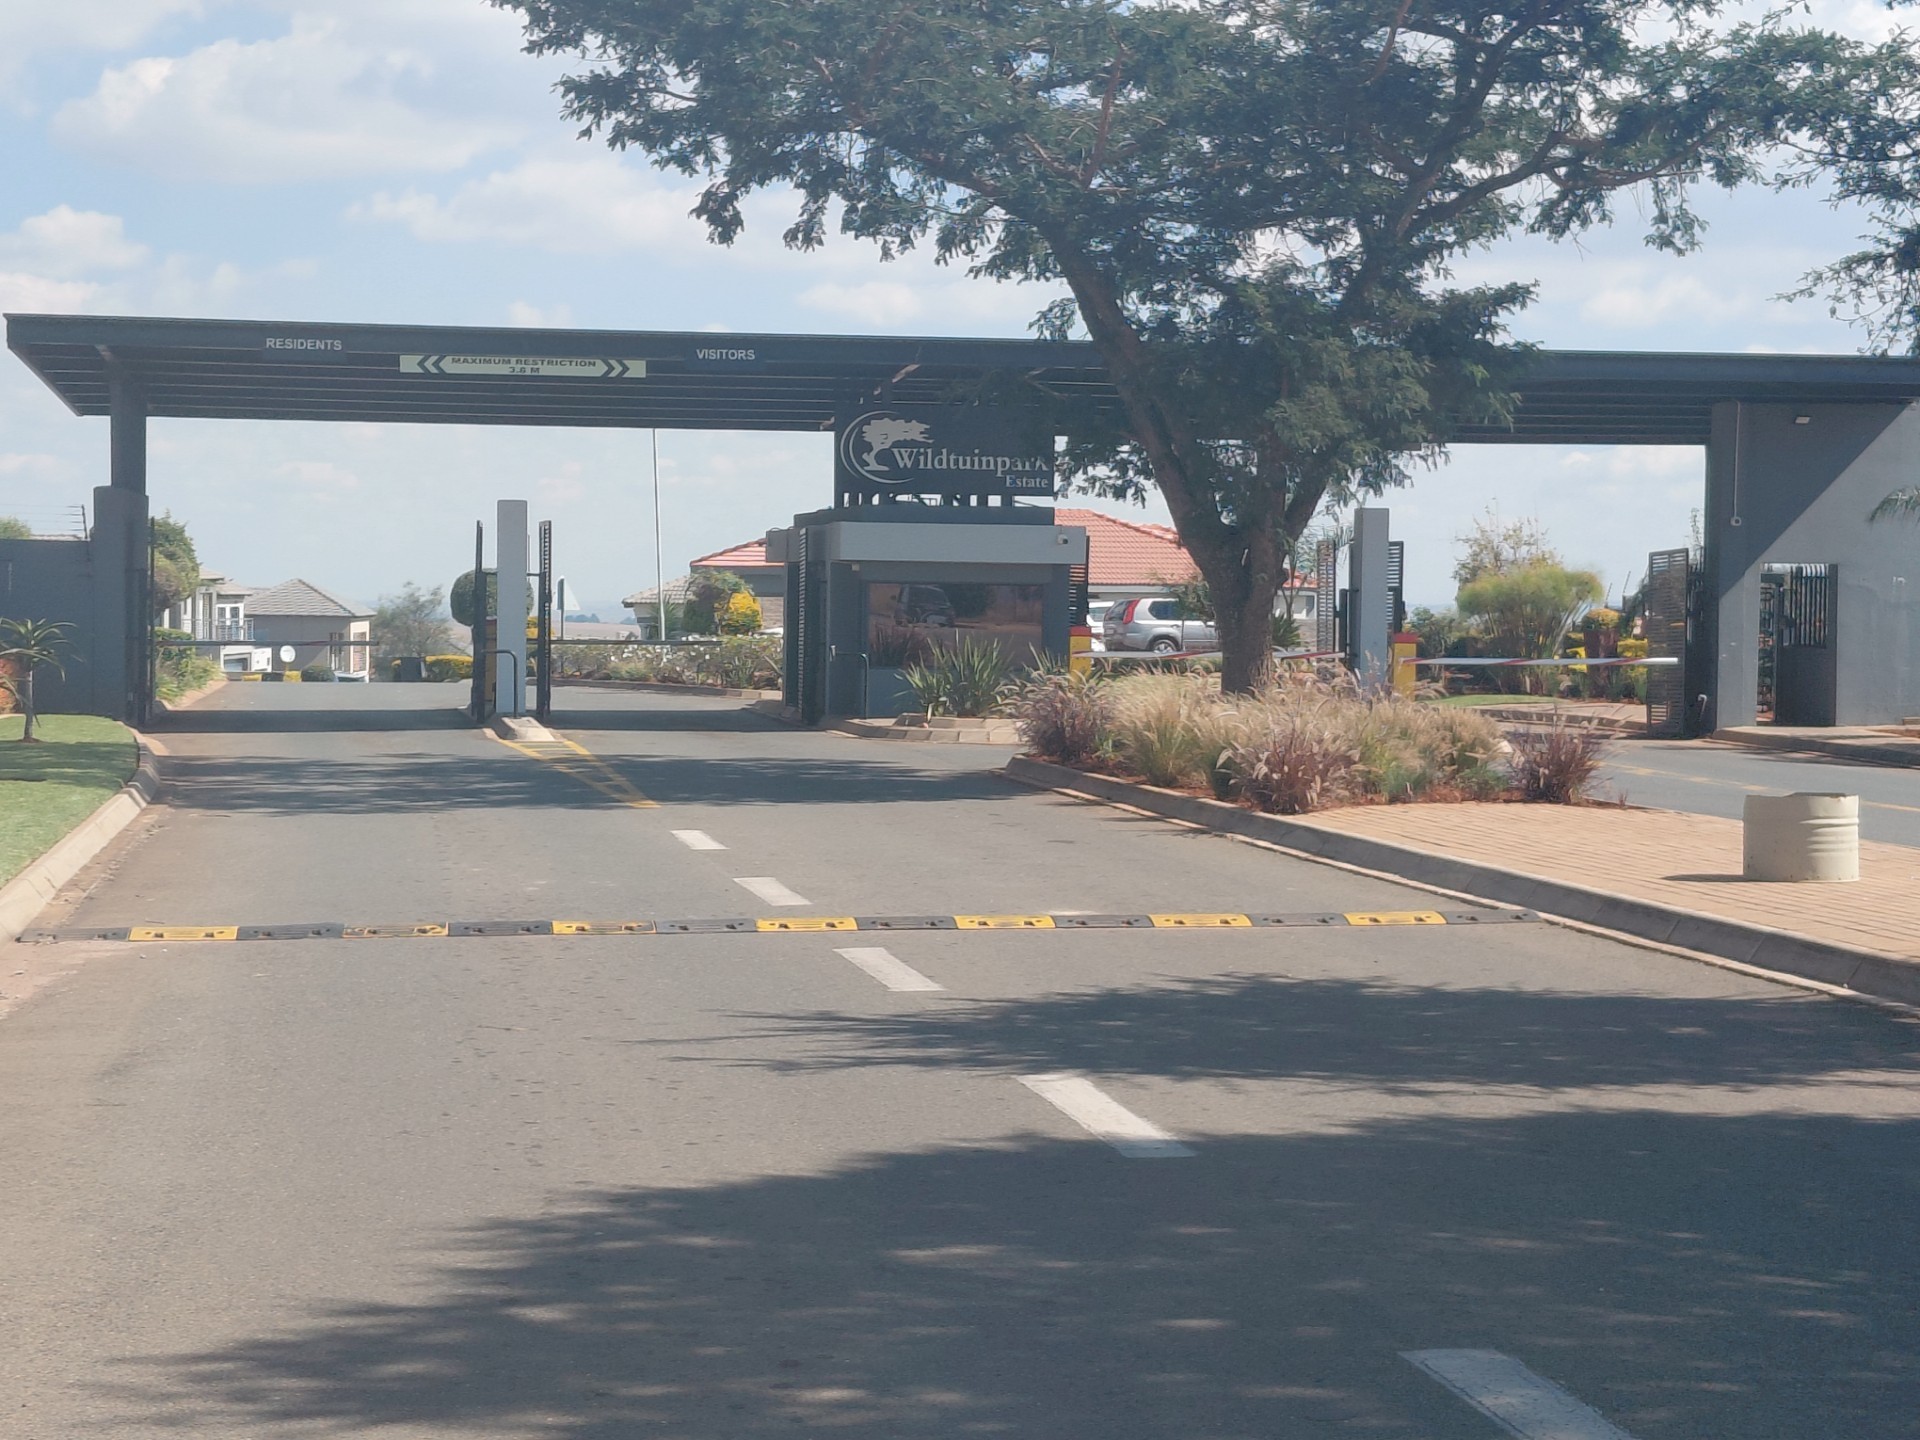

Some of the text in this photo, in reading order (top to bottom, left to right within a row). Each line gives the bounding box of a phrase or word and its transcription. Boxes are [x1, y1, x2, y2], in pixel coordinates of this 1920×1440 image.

[265, 338, 342, 350] RESIDENTS
[696, 349, 756, 360] VISITORS
[451, 357, 597, 367] MAXIMUM RESTRICTION
[1005, 474, 1049, 488] Estate
